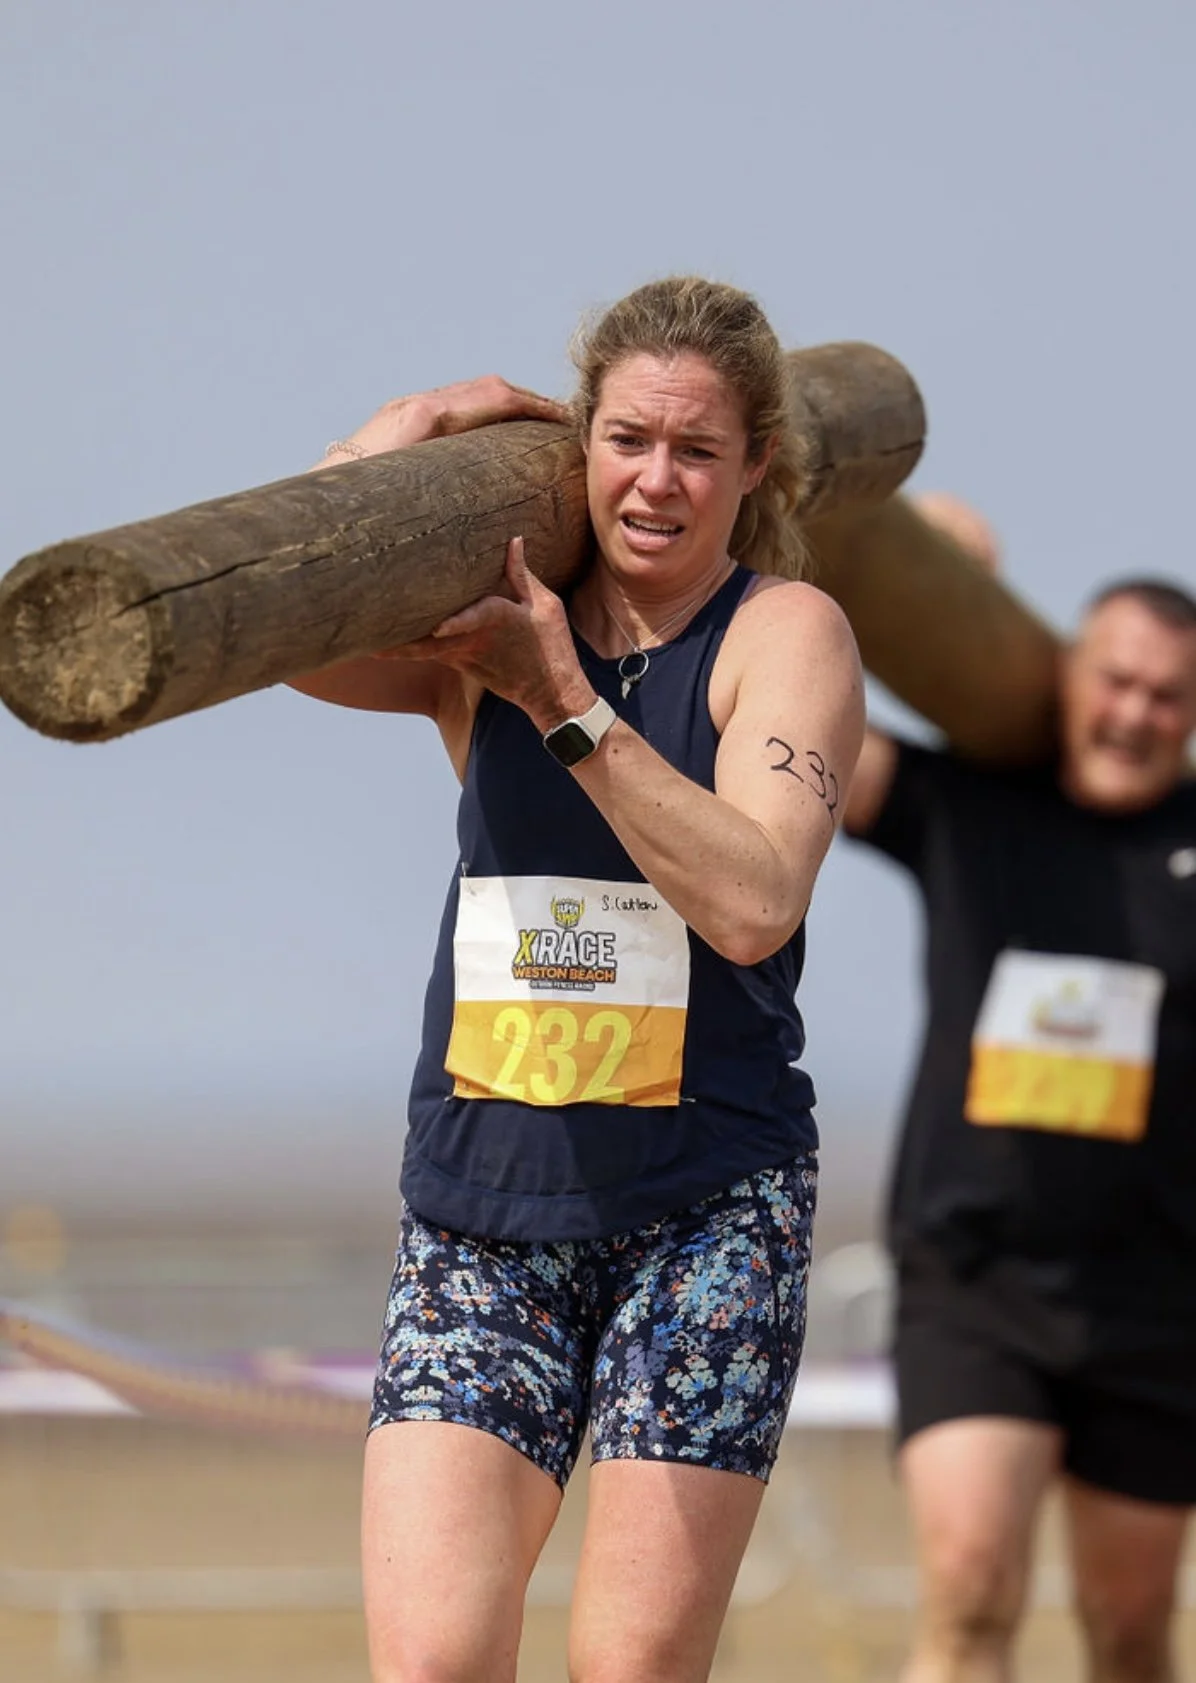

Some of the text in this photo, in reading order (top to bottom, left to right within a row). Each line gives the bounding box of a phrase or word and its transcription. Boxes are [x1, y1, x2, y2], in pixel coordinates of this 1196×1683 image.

[513, 966, 615, 982] WESTON BEACH
[489, 1006, 632, 1104] 232
